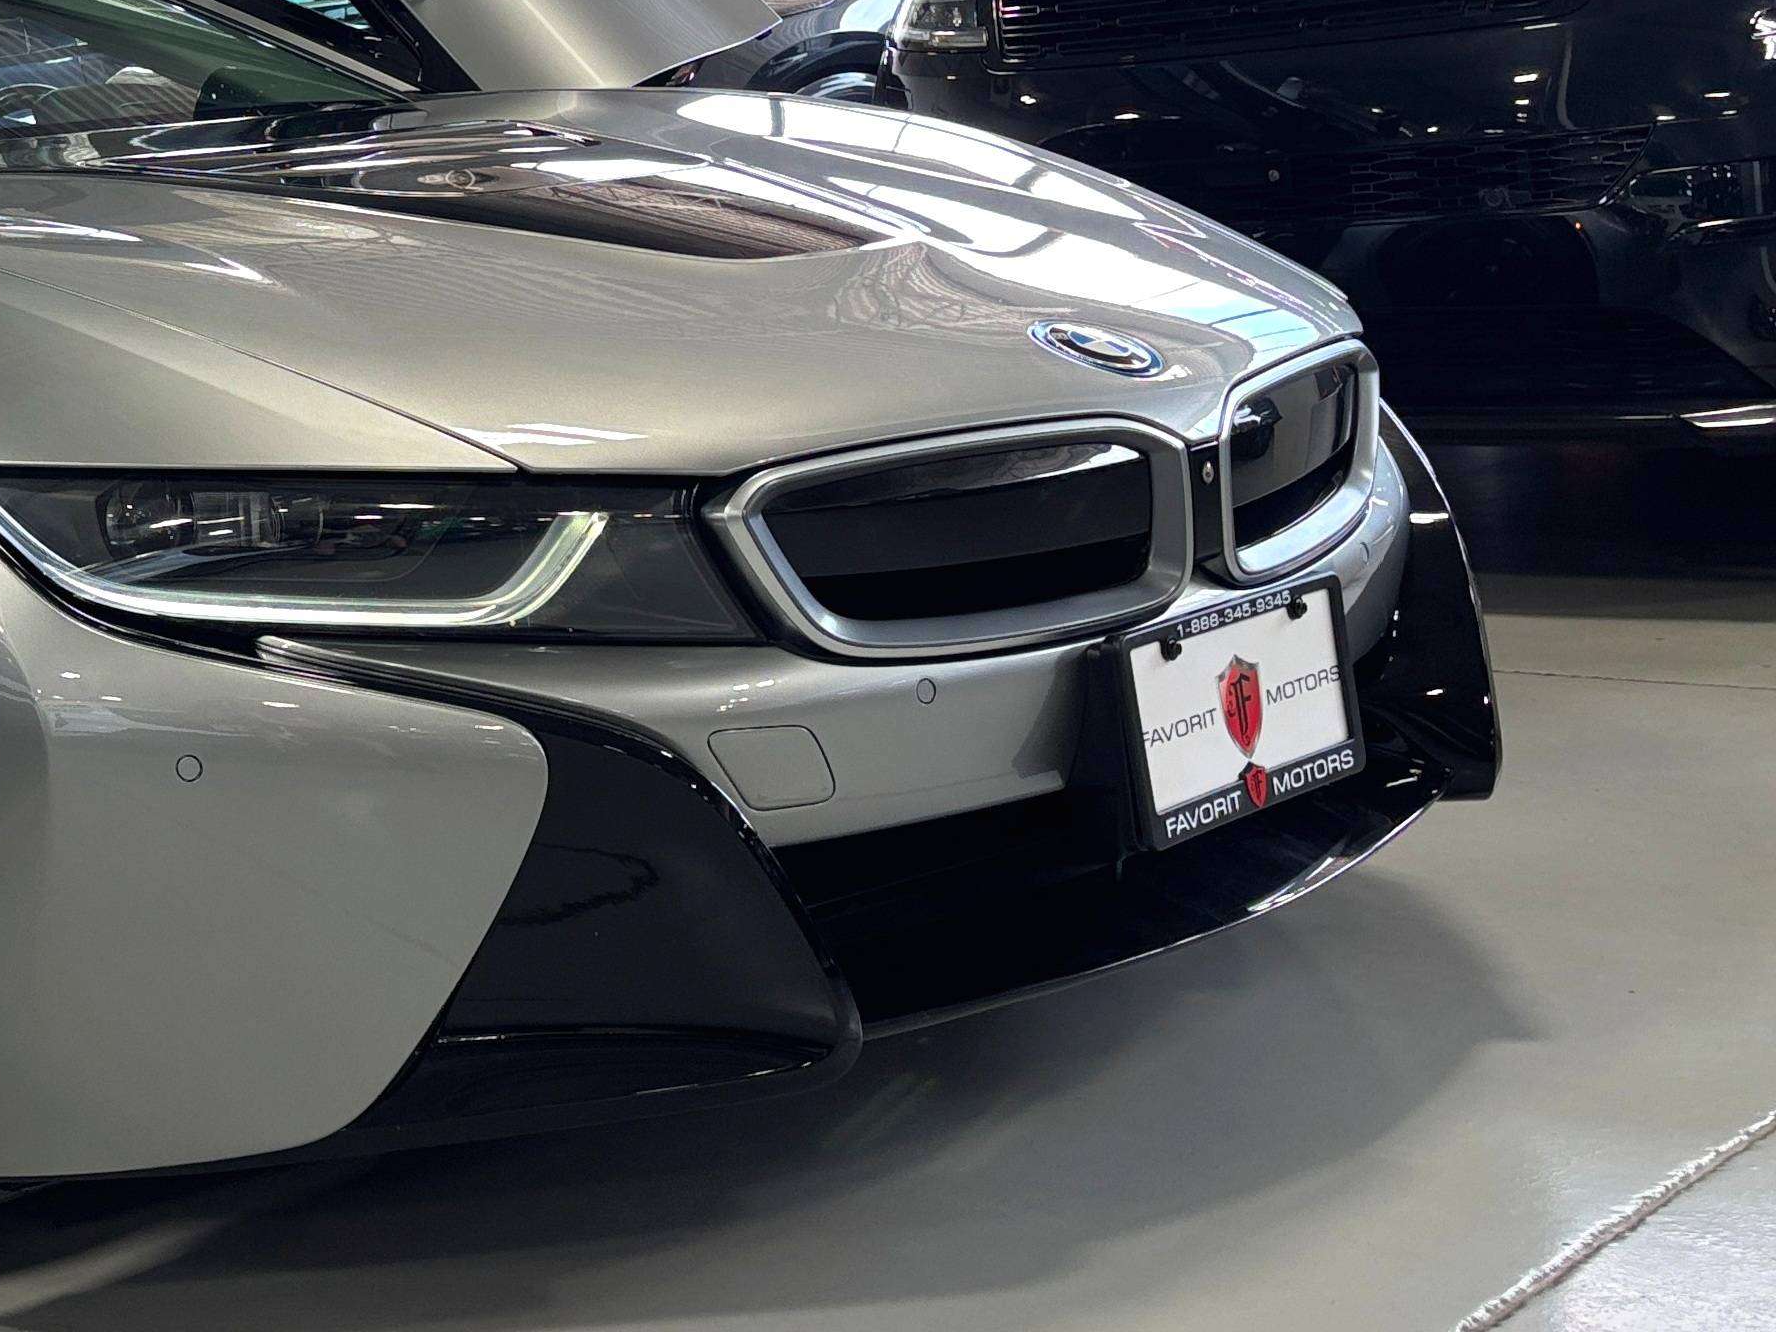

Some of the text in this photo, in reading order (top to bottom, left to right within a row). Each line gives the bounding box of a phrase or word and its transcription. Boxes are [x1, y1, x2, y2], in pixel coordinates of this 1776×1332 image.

[1177, 590, 1292, 638] 1-888-345-9345
[1141, 708, 1217, 748] FAVORIT
[1266, 665, 1342, 705] MOTORS
[1165, 791, 1242, 839] FAVORIT
[1272, 749, 1355, 796] MOTORS
